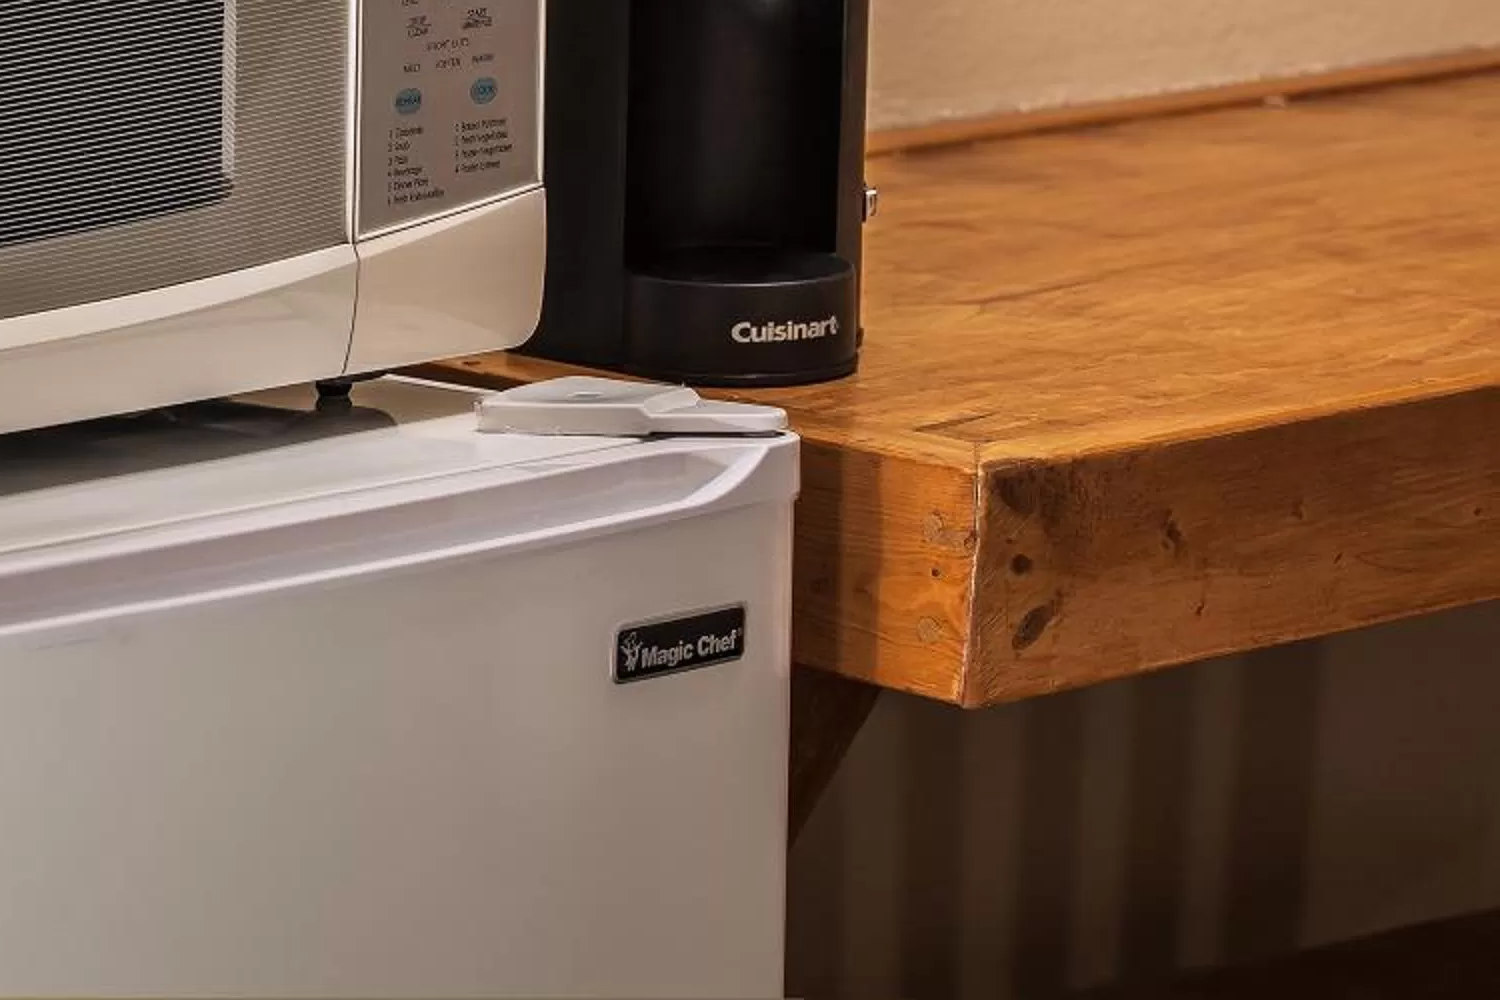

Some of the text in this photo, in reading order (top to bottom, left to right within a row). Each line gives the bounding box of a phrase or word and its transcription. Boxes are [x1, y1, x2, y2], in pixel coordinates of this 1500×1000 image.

[731, 315, 838, 343] Cuisinart
[641, 629, 737, 669] Magic Chef
